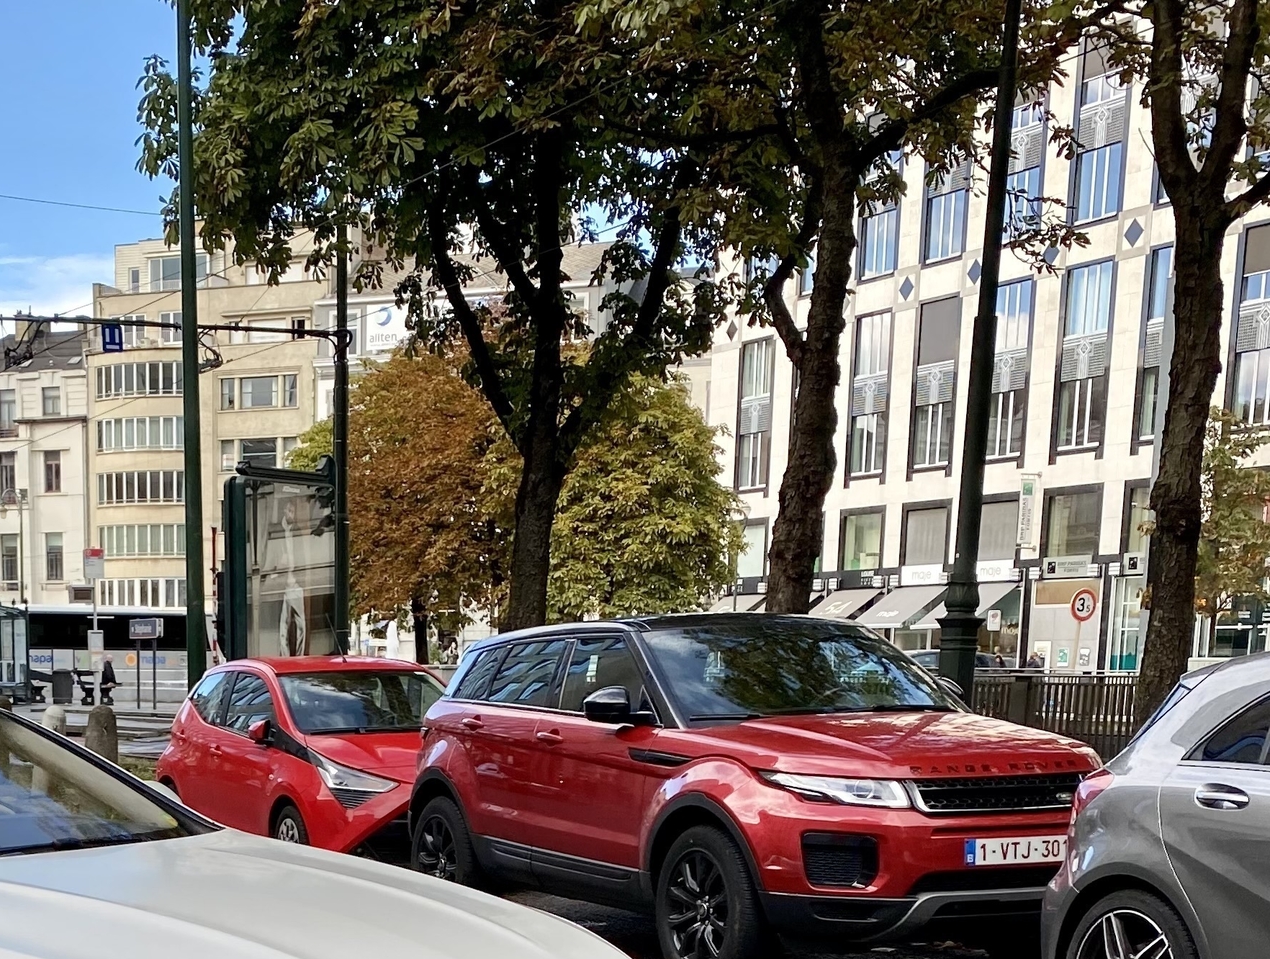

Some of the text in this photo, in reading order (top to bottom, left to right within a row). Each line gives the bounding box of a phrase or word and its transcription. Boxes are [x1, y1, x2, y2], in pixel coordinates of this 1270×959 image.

[909, 759, 1077, 775] RANGE ROVER
[980, 839, 1067, 861] 1-VTJ-30
